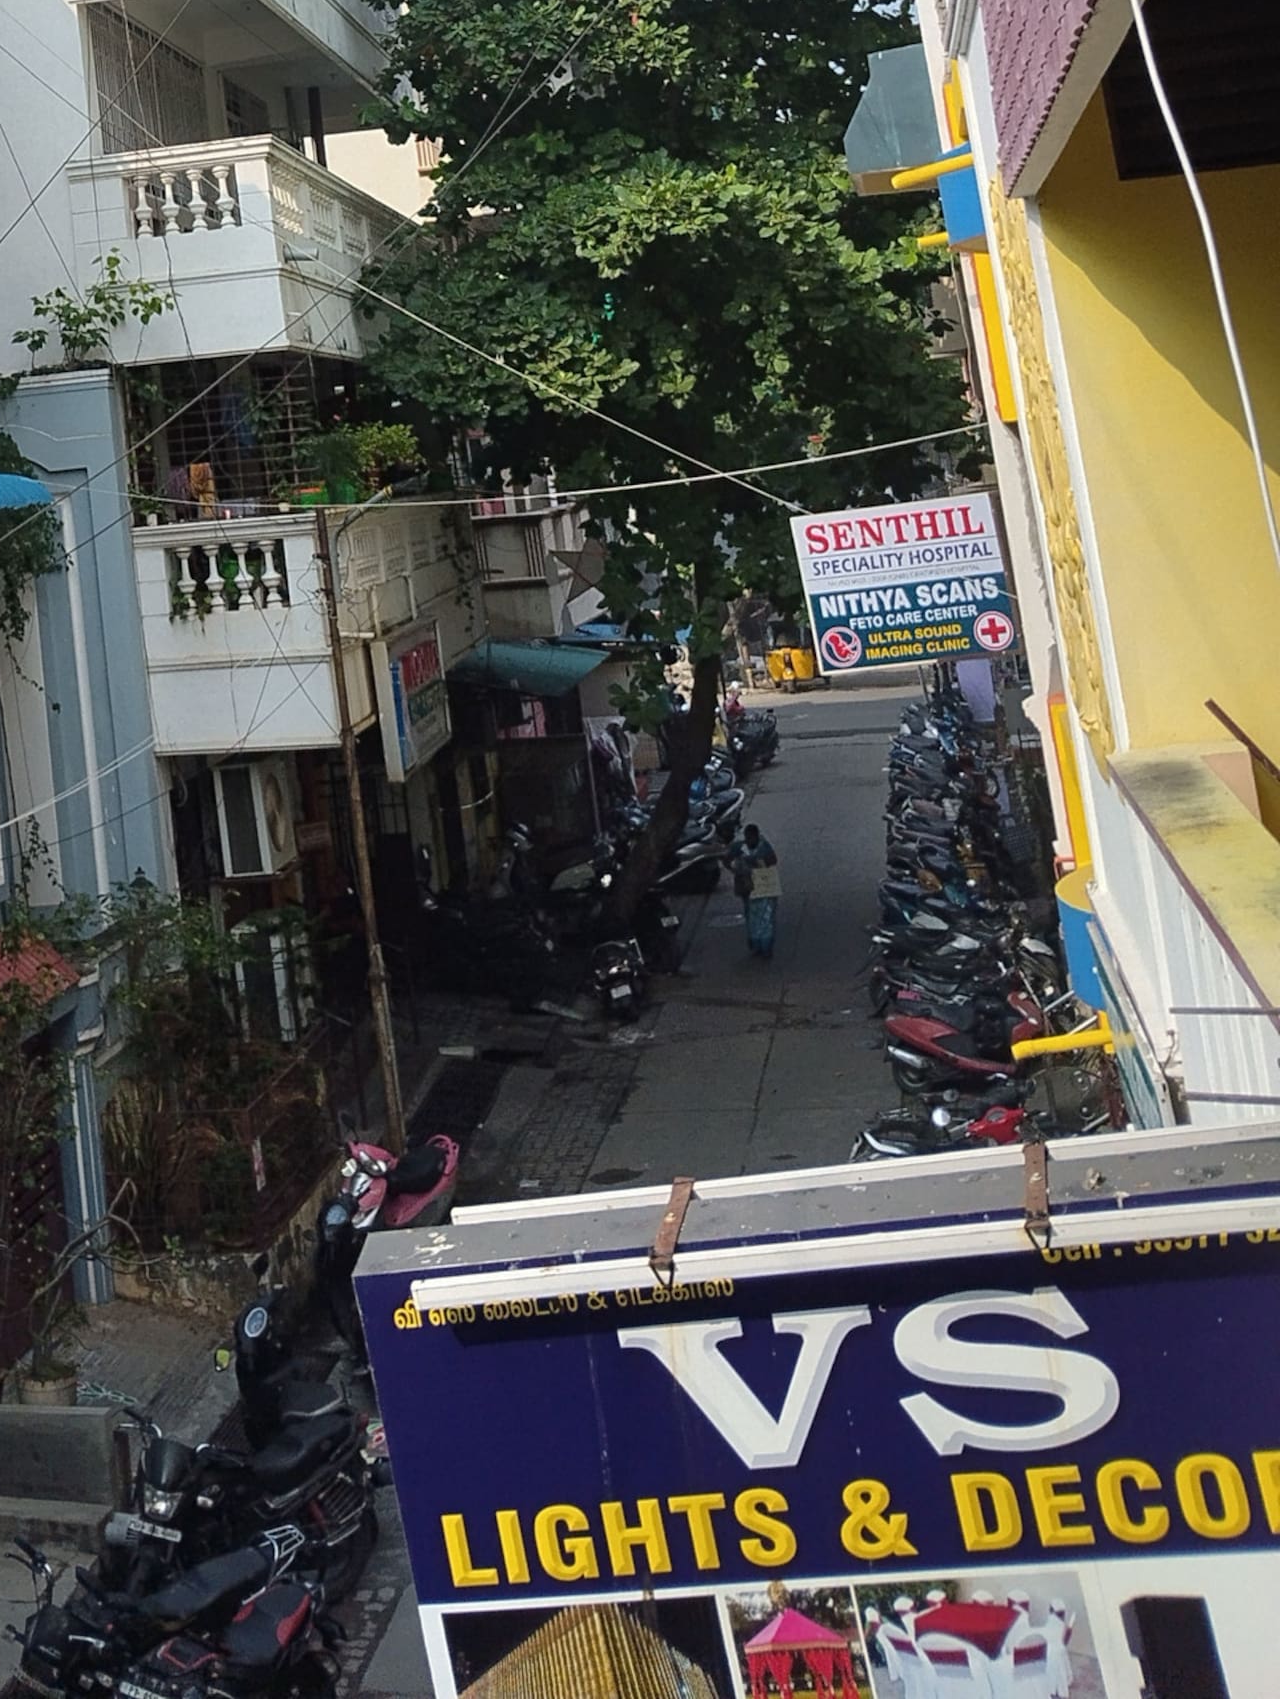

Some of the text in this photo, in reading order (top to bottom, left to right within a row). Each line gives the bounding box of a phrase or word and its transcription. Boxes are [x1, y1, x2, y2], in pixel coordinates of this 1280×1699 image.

[805, 506, 985, 555] SENTHIL
[813, 552, 903, 576] SPECIALITY
[909, 542, 993, 565] HOSPITAL
[820, 577, 999, 619] NITHYA SCANS
[849, 604, 978, 631] FETO CARE CENTER
[868, 623, 962, 645] ULTRA SOUND
[866, 637, 970, 660] IMAGING CLINIC
[617, 1286, 1121, 1470] VS
[440, 1487, 798, 1589] LIGHTS
[841, 1478, 918, 1561] &
